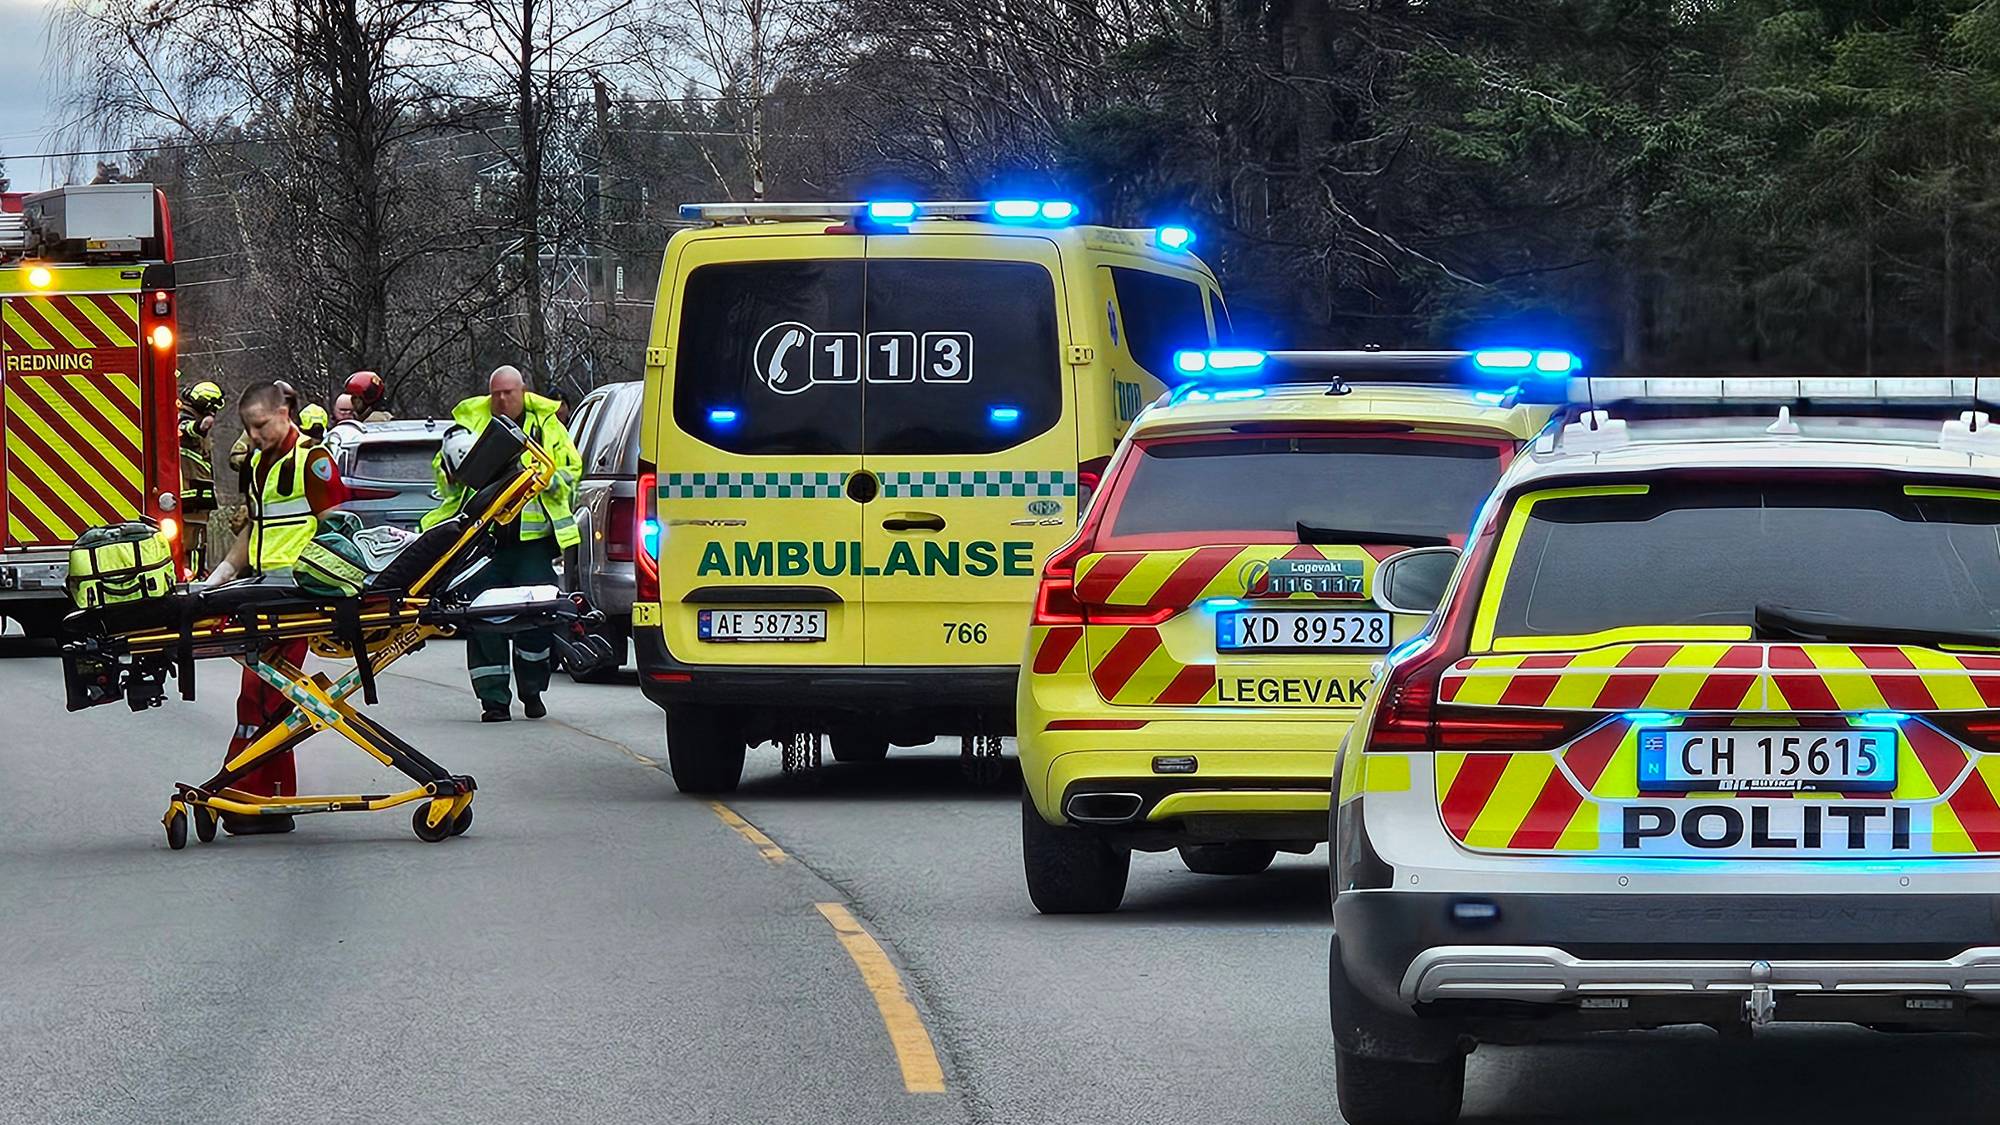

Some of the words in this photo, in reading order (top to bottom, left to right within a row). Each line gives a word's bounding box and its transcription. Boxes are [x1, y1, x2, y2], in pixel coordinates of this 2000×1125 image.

[6, 353, 93, 371] REDNING
[697, 541, 1034, 577] AMBULANSE
[717, 614, 743, 634] AE
[753, 614, 818, 634] 58735
[943, 623, 988, 644] 766
[1242, 617, 1280, 644] XD
[1293, 617, 1384, 644] 89528
[1218, 678, 1376, 703] LEGEVAK
[1681, 737, 1735, 776] CH
[1757, 737, 1878, 776] 15615
[1622, 804, 1911, 850] POLITI
